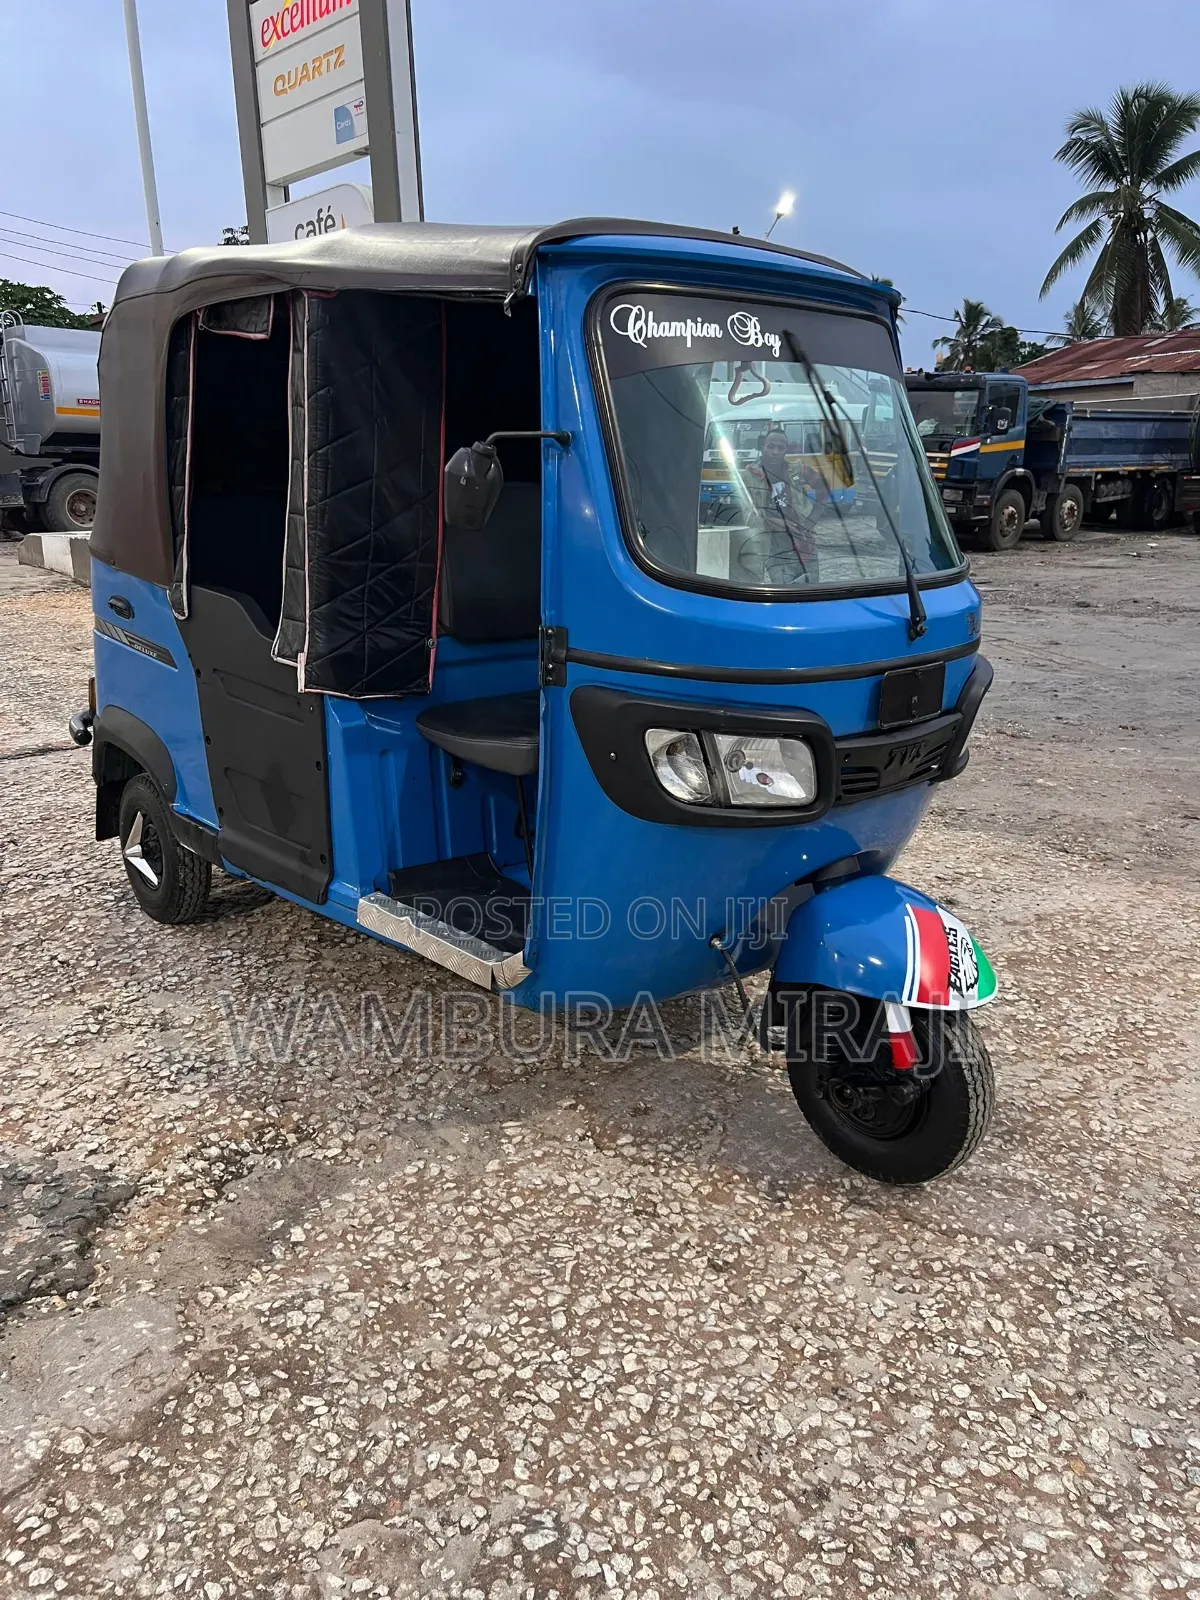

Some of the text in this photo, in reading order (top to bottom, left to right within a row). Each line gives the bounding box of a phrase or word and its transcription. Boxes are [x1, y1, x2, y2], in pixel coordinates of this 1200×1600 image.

[273, 44, 346, 97] QUARTZ
[336, 119, 351, 130] Cards
[294, 205, 336, 240] café
[610, 304, 782, 358] Champion Boy
[134, 643, 158, 658] DELUXE
[944, 925, 965, 999] EAGLES
